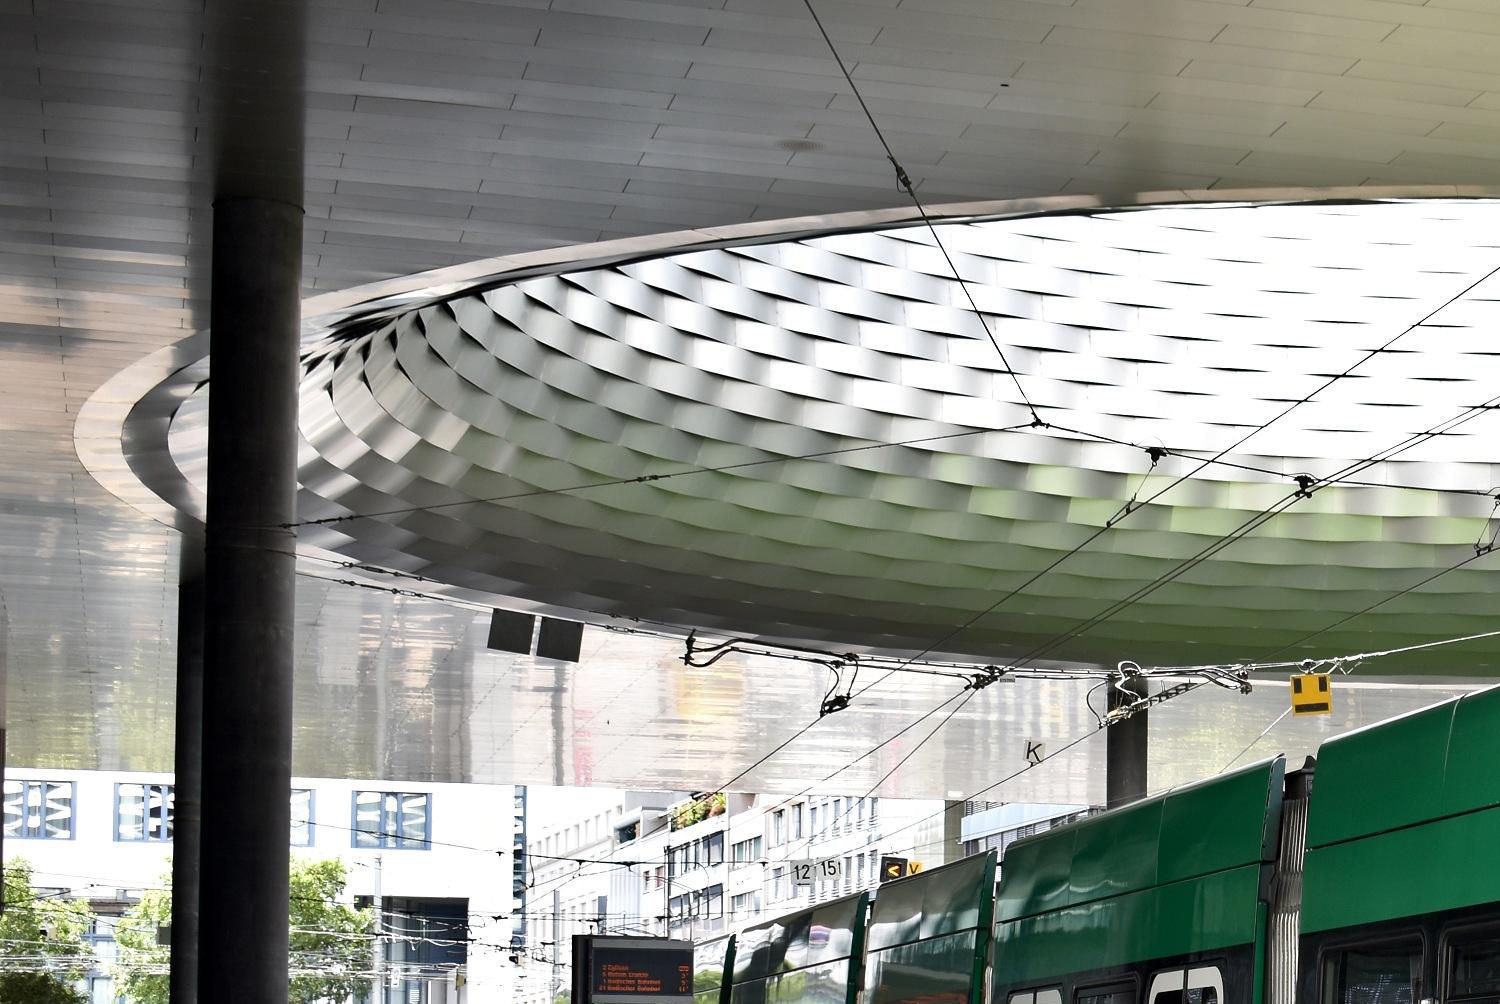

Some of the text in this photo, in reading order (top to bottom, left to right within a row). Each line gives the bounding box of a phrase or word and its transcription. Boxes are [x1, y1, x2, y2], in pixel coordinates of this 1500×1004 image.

[1026, 741, 1042, 762] K
[794, 864, 811, 880] 12
[909, 863, 919, 874] V
